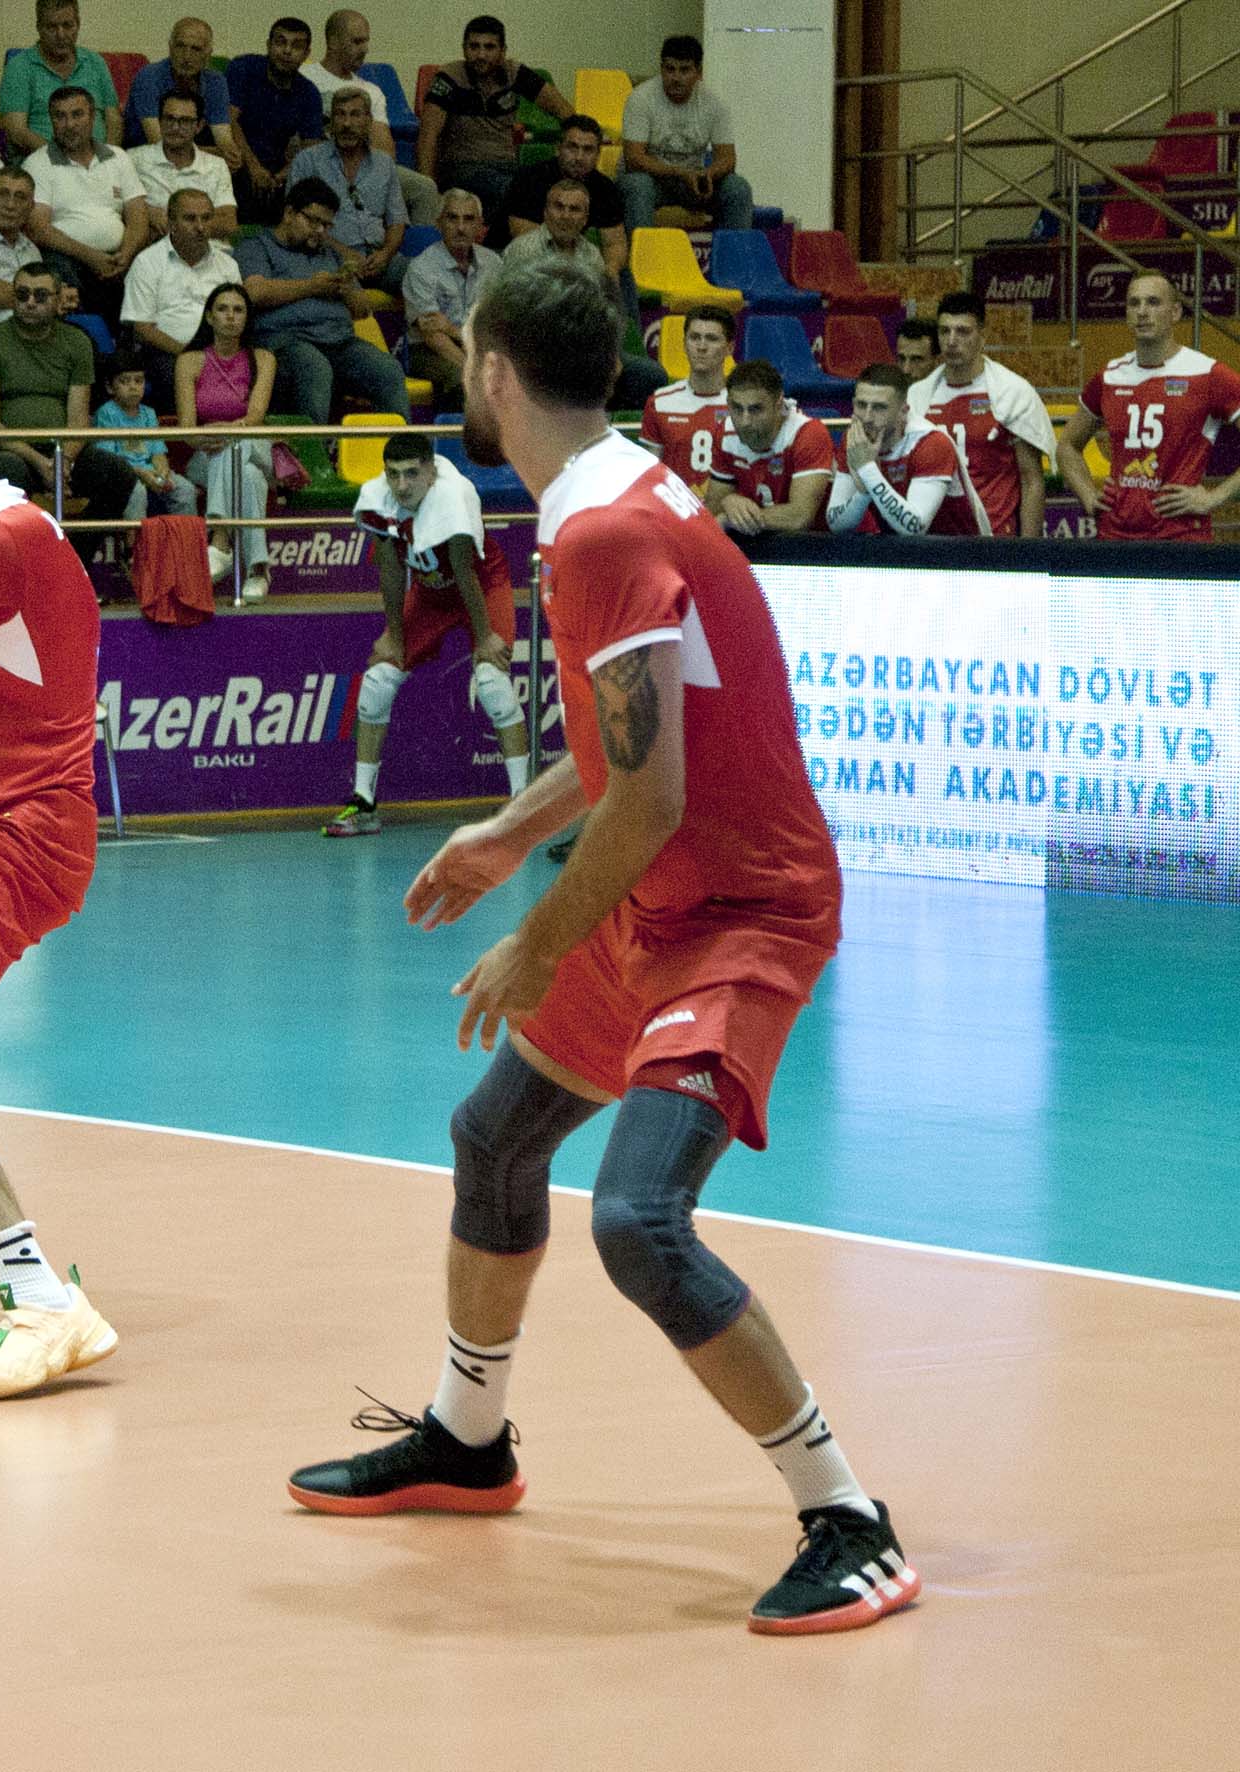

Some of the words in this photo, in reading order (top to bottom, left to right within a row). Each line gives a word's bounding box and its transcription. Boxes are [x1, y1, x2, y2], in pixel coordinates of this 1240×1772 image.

[985, 272, 1055, 300] AzerRail
[1124, 403, 1165, 449] 15
[690, 429, 713, 473] 8
[795, 651, 1041, 698] AZƏRBAYCAN
[1059, 656, 1217, 709] DÖVLƏT
[96, 672, 337, 751] AzerRail
[193, 753, 255, 768] BAKU
[1160, 725, 1214, 766] VƏ
